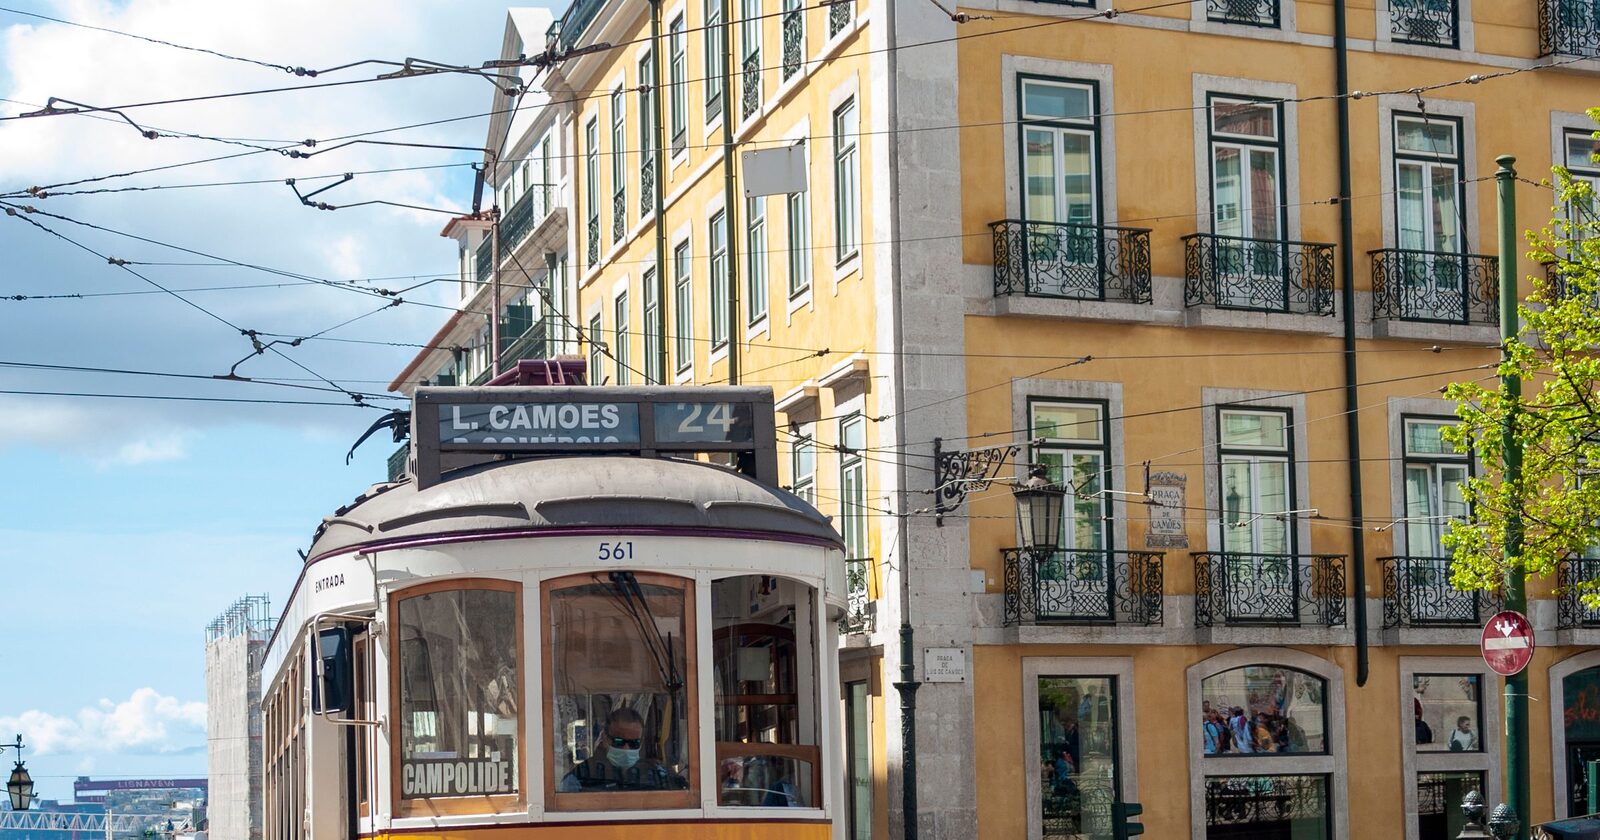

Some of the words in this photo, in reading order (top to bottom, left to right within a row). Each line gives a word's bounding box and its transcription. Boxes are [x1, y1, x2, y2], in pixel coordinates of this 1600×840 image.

[452, 405, 479, 430] L.
[677, 402, 735, 432] 24
[1152, 490, 1180, 500] PRAÇA
[598, 541, 633, 561] 561
[315, 573, 345, 593] ENTRADA
[402, 762, 509, 795] CAMPOLIDE
